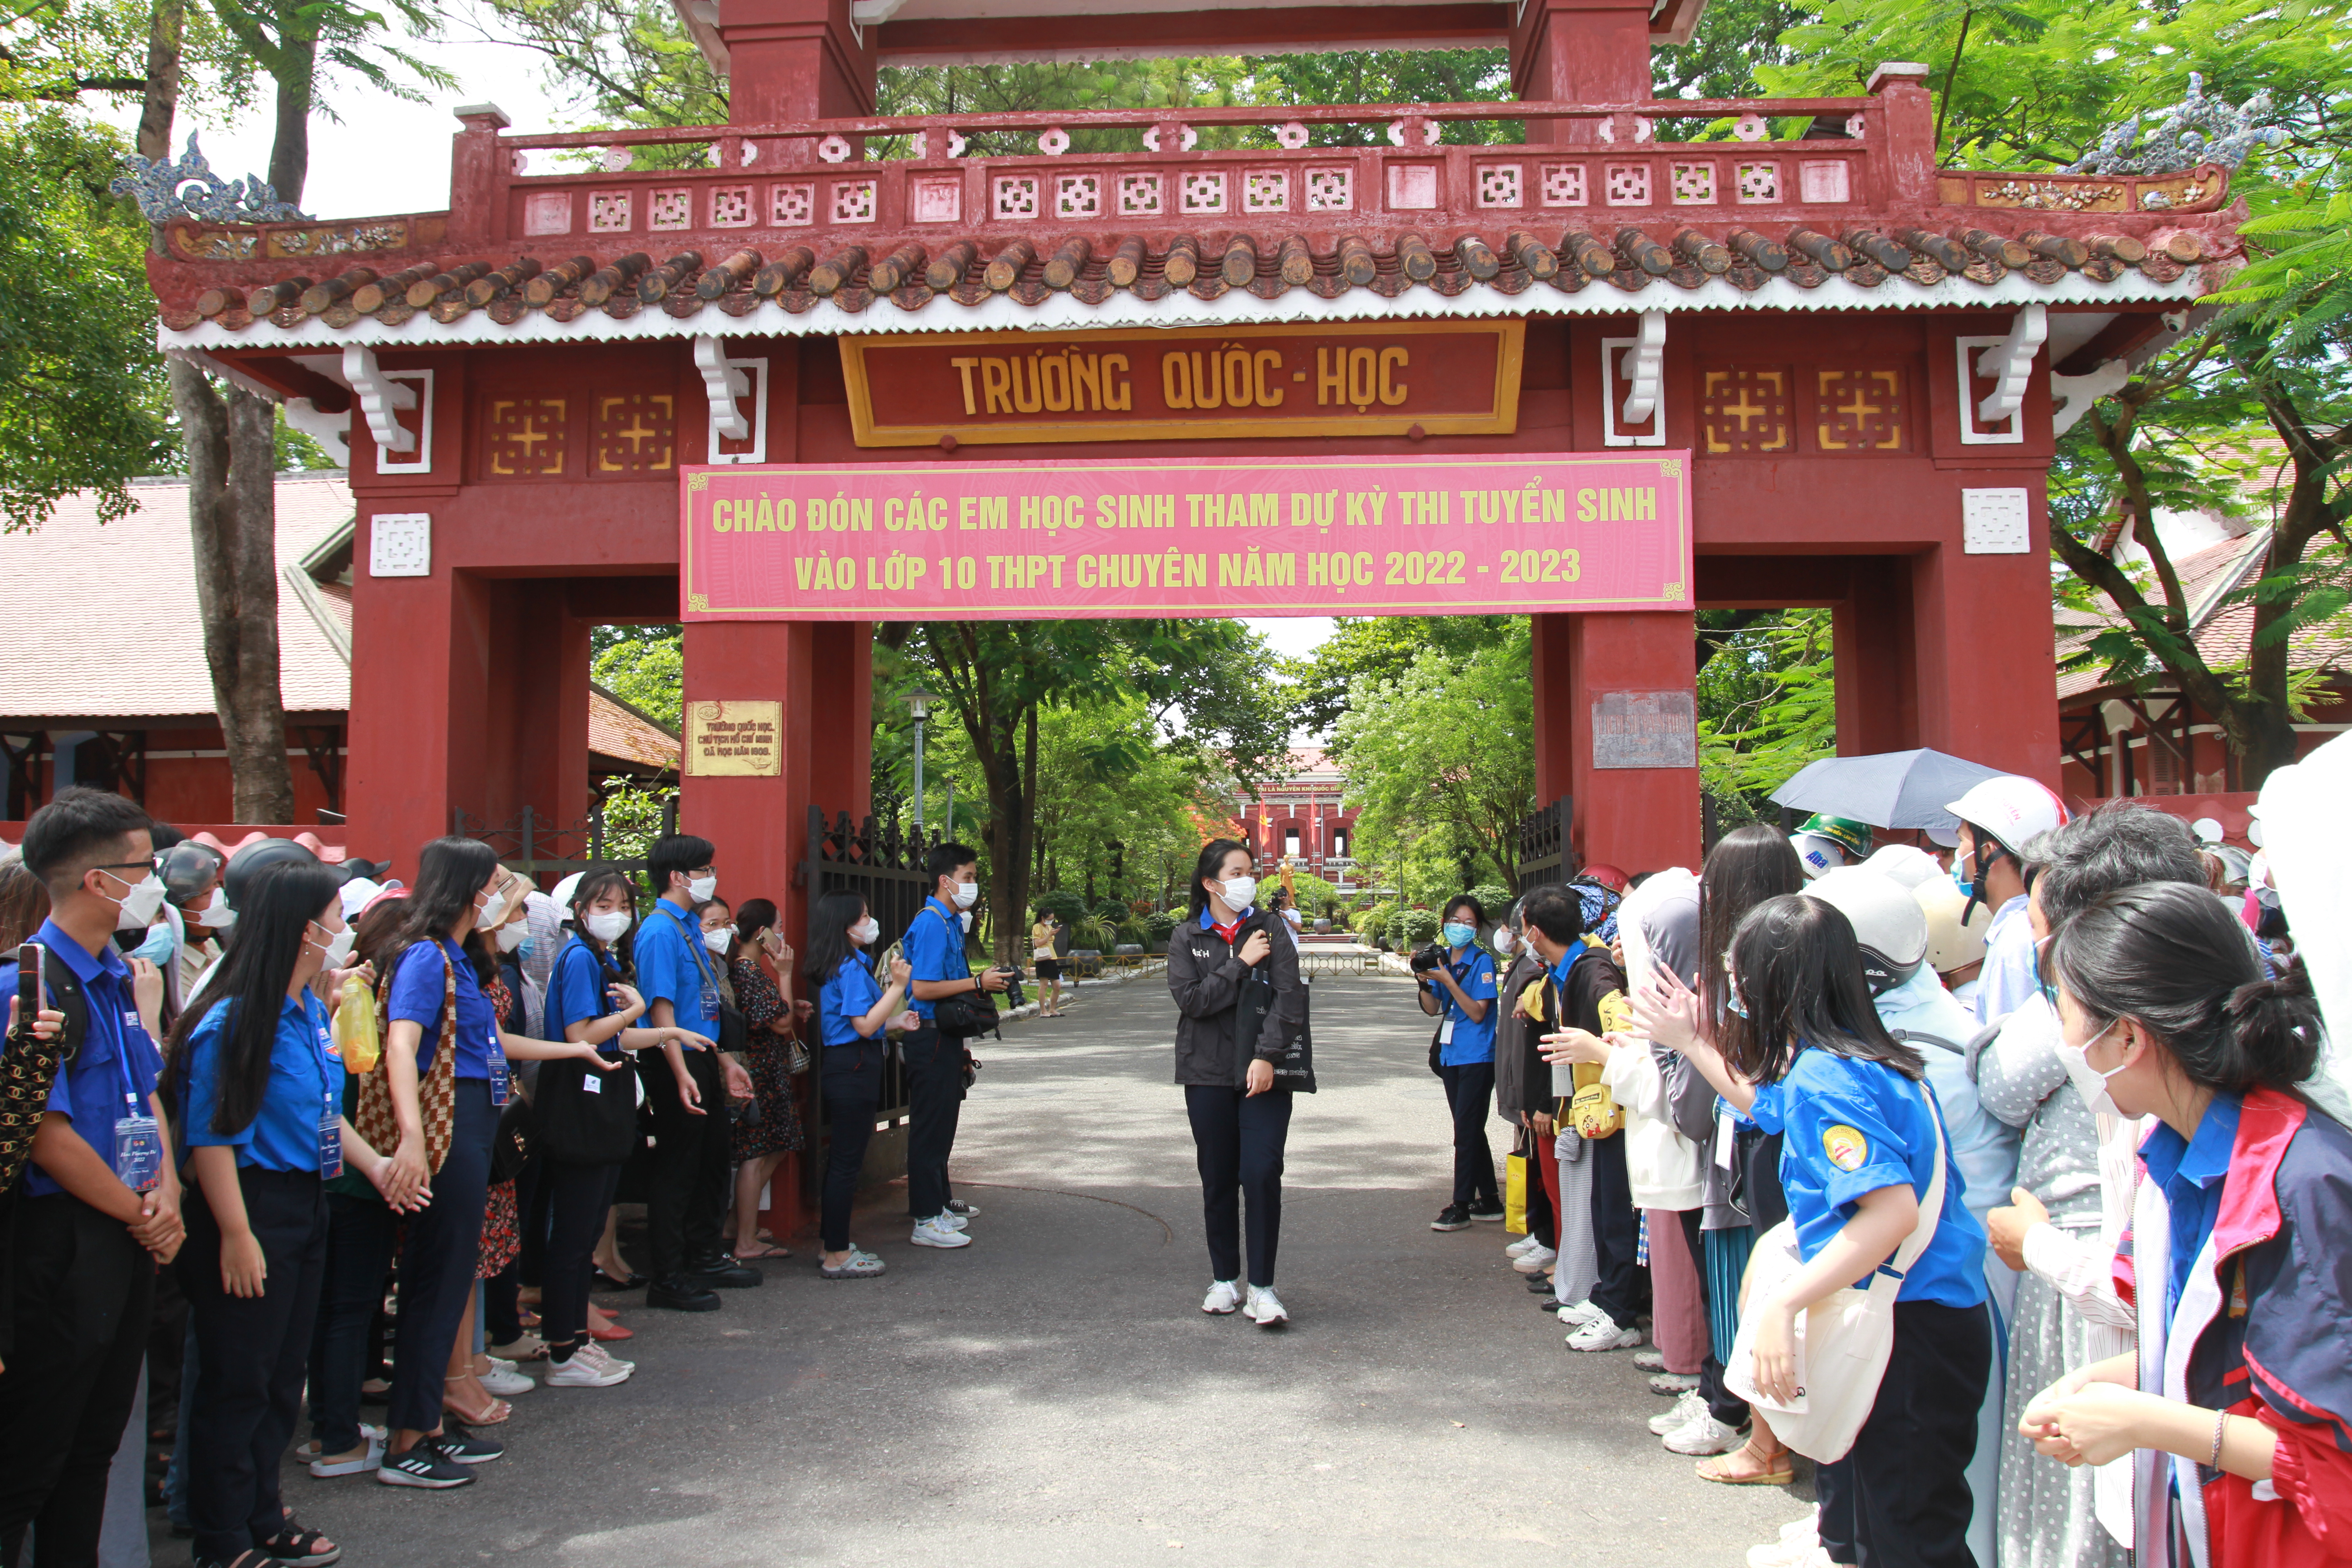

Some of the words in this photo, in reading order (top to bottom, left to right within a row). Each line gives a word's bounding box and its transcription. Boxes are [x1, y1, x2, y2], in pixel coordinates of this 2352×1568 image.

[951, 343, 1131, 415] TRƯỜNG
[1162, 341, 1283, 409] QUỐC
[1318, 347, 1409, 414] HỌC
[713, 491, 797, 533] CHÀO
[807, 491, 873, 532] ĐÓN
[884, 490, 948, 532] CÁC
[960, 496, 1008, 530] EM
[1020, 495, 1085, 536] HỌC
[1097, 494, 1175, 529] SINH
[1186, 493, 1279, 528] THAM
[1291, 489, 1338, 534] DỰ
[1347, 485, 1388, 526] KỲ
[1398, 490, 1449, 525] THI
[1460, 475, 1565, 524] TUYỂN
[1578, 487, 1656, 522] SINH
[794, 549, 857, 591] VÀO
[867, 549, 927, 591] LỚP
[939, 556, 976, 590] 10
[987, 554, 1067, 589] THPT
[1077, 546, 1207, 588] CHUYÊN
[1219, 545, 1296, 587] NĂM
[1308, 551, 1374, 593] HỌC
[1385, 550, 1466, 585] 2022
[1500, 548, 1581, 583] 2023
